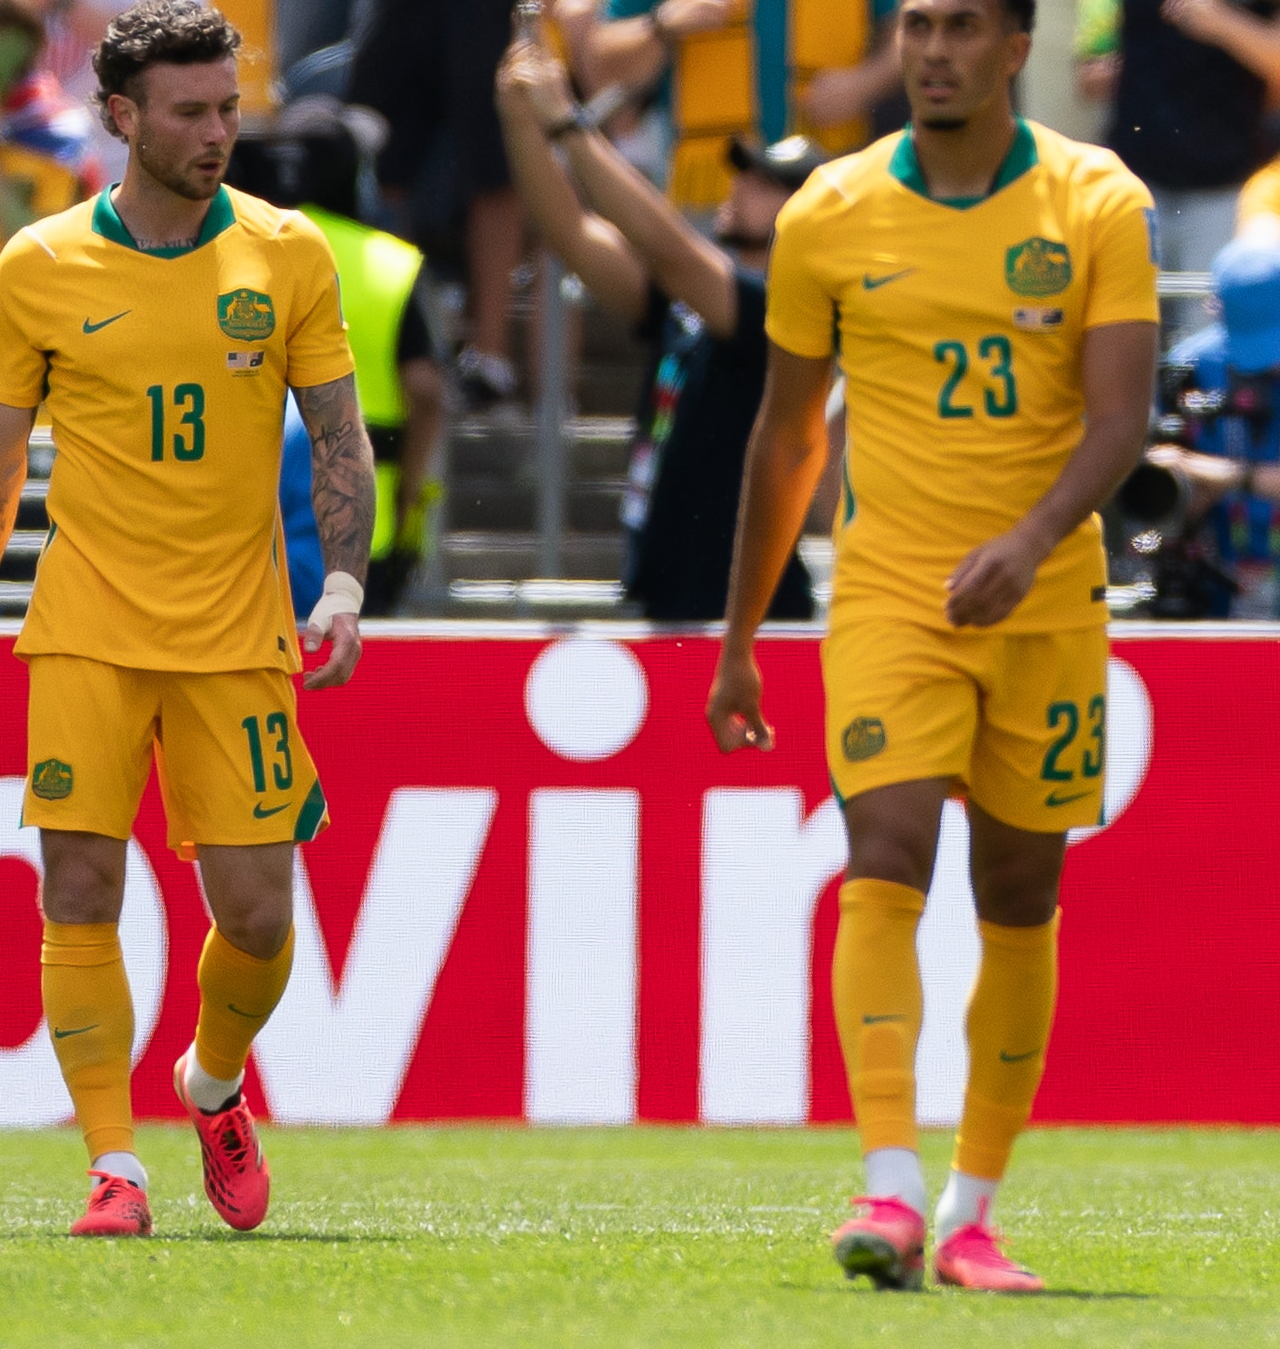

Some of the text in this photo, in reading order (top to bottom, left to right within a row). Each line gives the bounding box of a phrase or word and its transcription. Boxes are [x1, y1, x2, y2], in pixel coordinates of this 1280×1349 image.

[933, 334, 1018, 419] 23
[146, 382, 206, 462] 13
[241, 712, 293, 793] 13
[1040, 694, 1106, 782] 23
